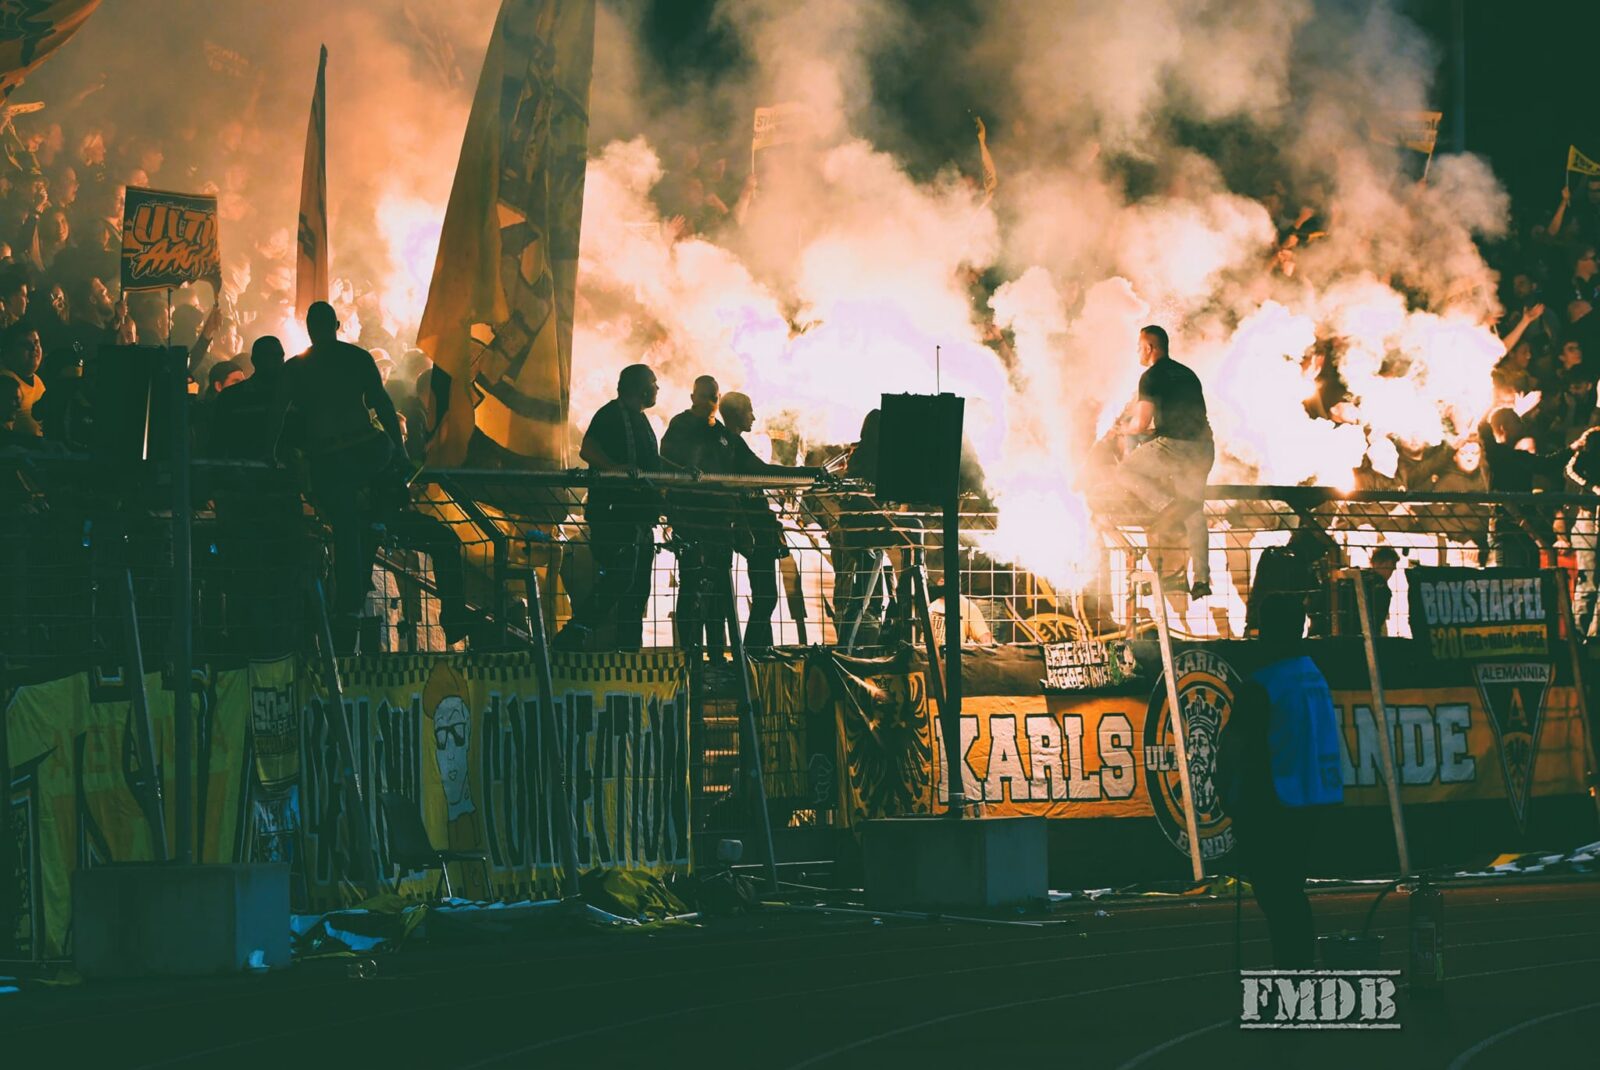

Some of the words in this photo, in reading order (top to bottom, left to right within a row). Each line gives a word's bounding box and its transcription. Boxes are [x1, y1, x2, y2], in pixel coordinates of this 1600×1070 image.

[1420, 577, 1546, 625] BOXSTAFFEL
[1481, 667, 1548, 680] ALEMANNIA
[934, 712, 1138, 804] KARLS
[1175, 826, 1236, 858] BNDE
